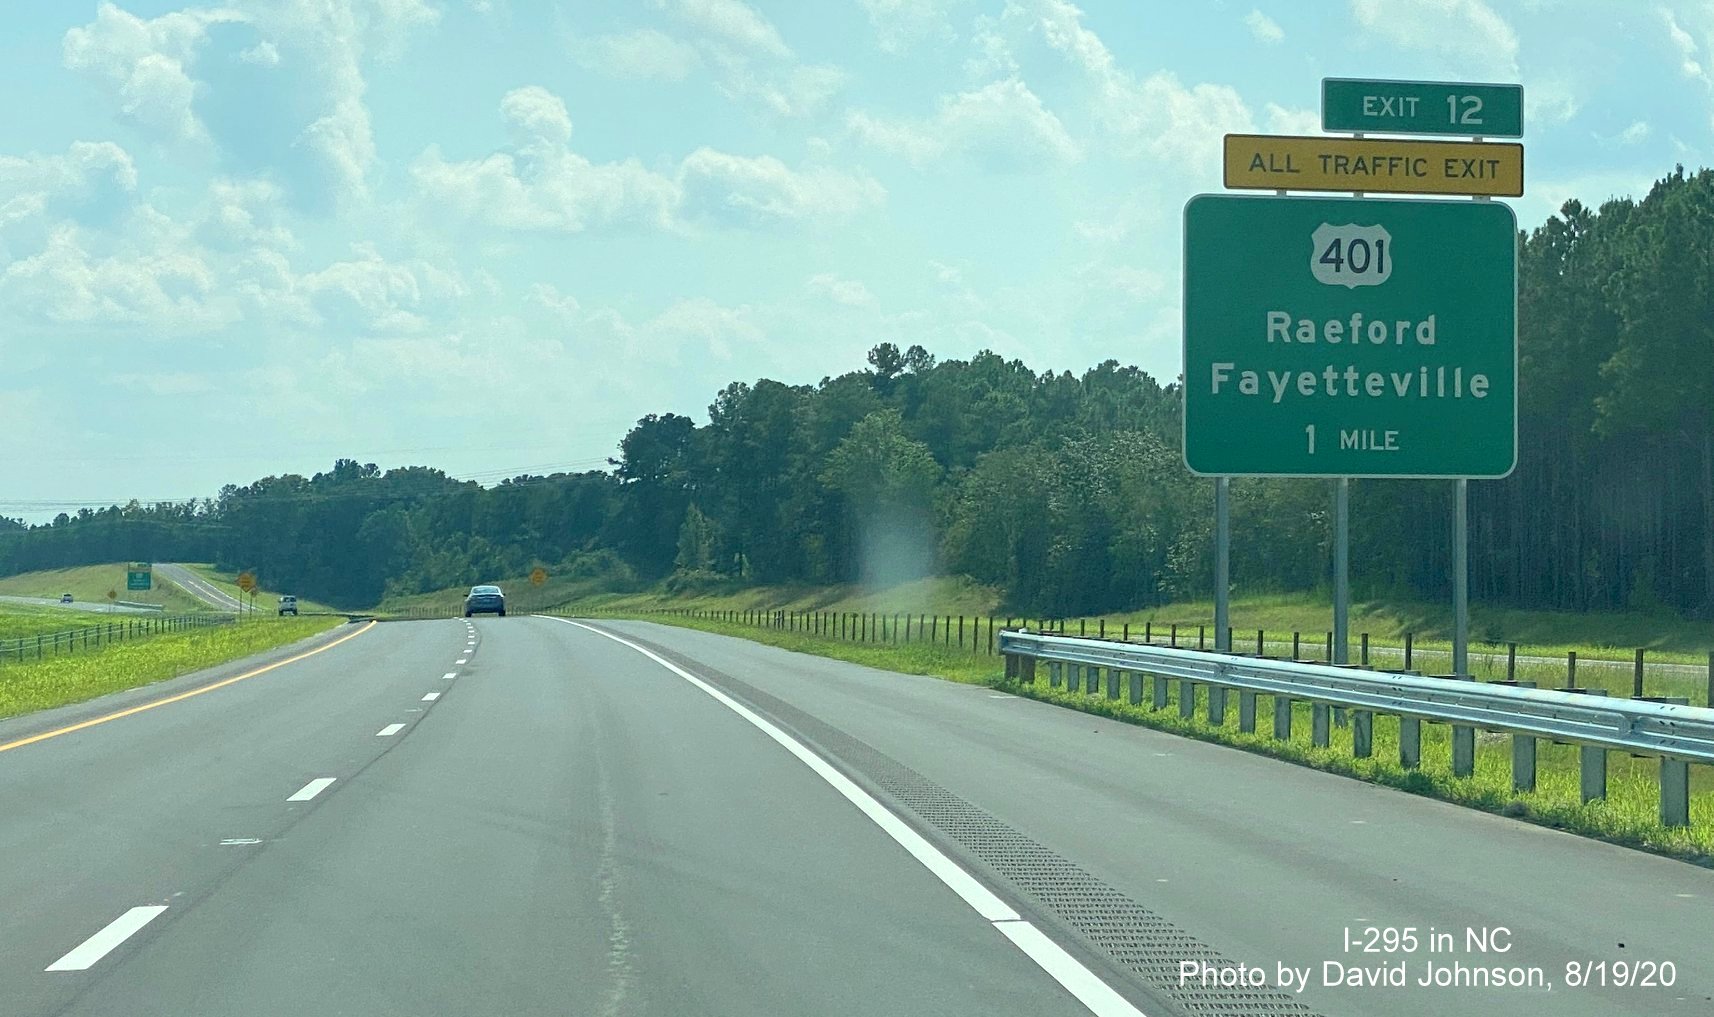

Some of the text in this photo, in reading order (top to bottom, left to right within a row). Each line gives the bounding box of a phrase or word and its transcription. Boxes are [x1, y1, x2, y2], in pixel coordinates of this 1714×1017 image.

[1363, 95, 1483, 125] EXIT 12
[1248, 152, 1500, 180] ALL TRAFFIC EXIT
[1319, 238, 1384, 274] 401
[1266, 311, 1437, 345] Raeford
[1211, 362, 1490, 404] Fayetteville
[1305, 424, 1400, 454] 1 MILE
